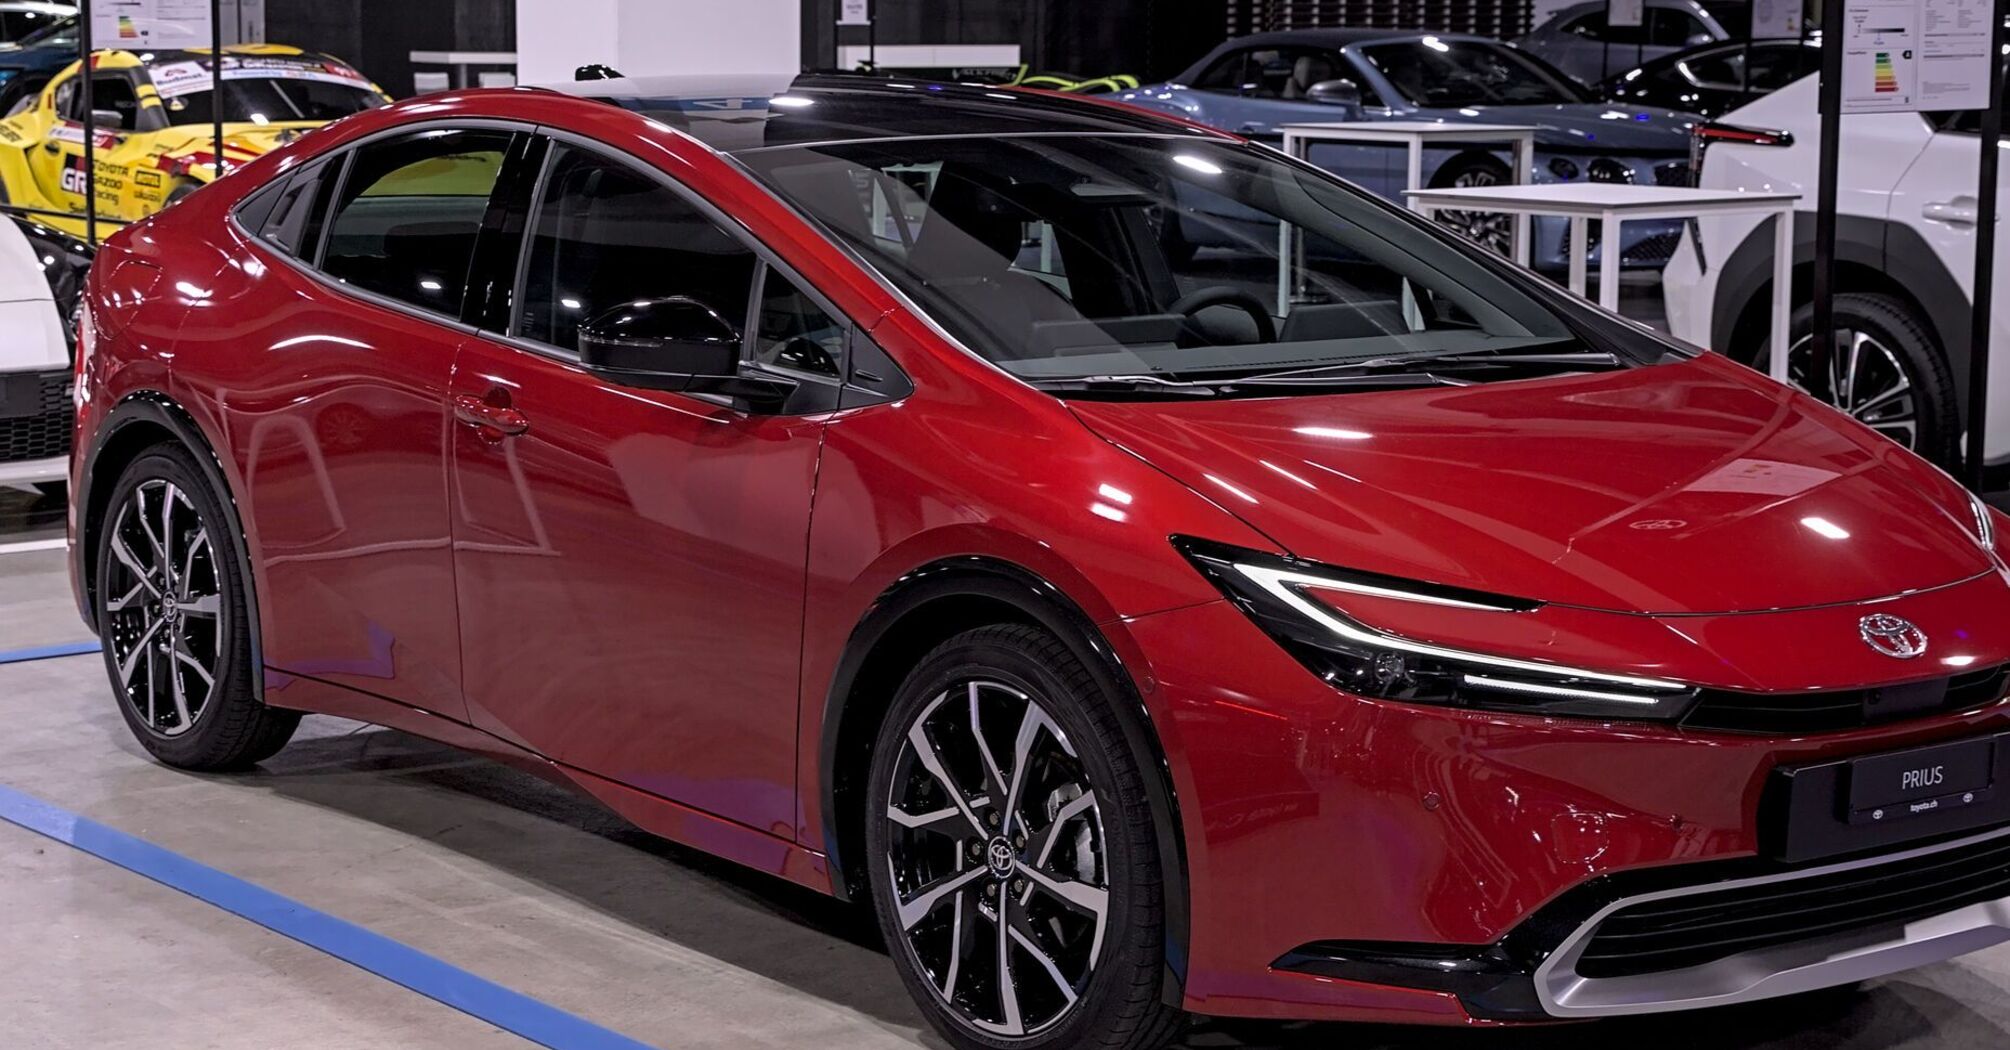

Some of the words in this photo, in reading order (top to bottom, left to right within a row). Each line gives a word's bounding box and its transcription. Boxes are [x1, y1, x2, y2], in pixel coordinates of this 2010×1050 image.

[61, 166, 87, 195] GR
[1902, 765, 1943, 790] PRIUS
[1910, 799, 1938, 813] toyota.ch
